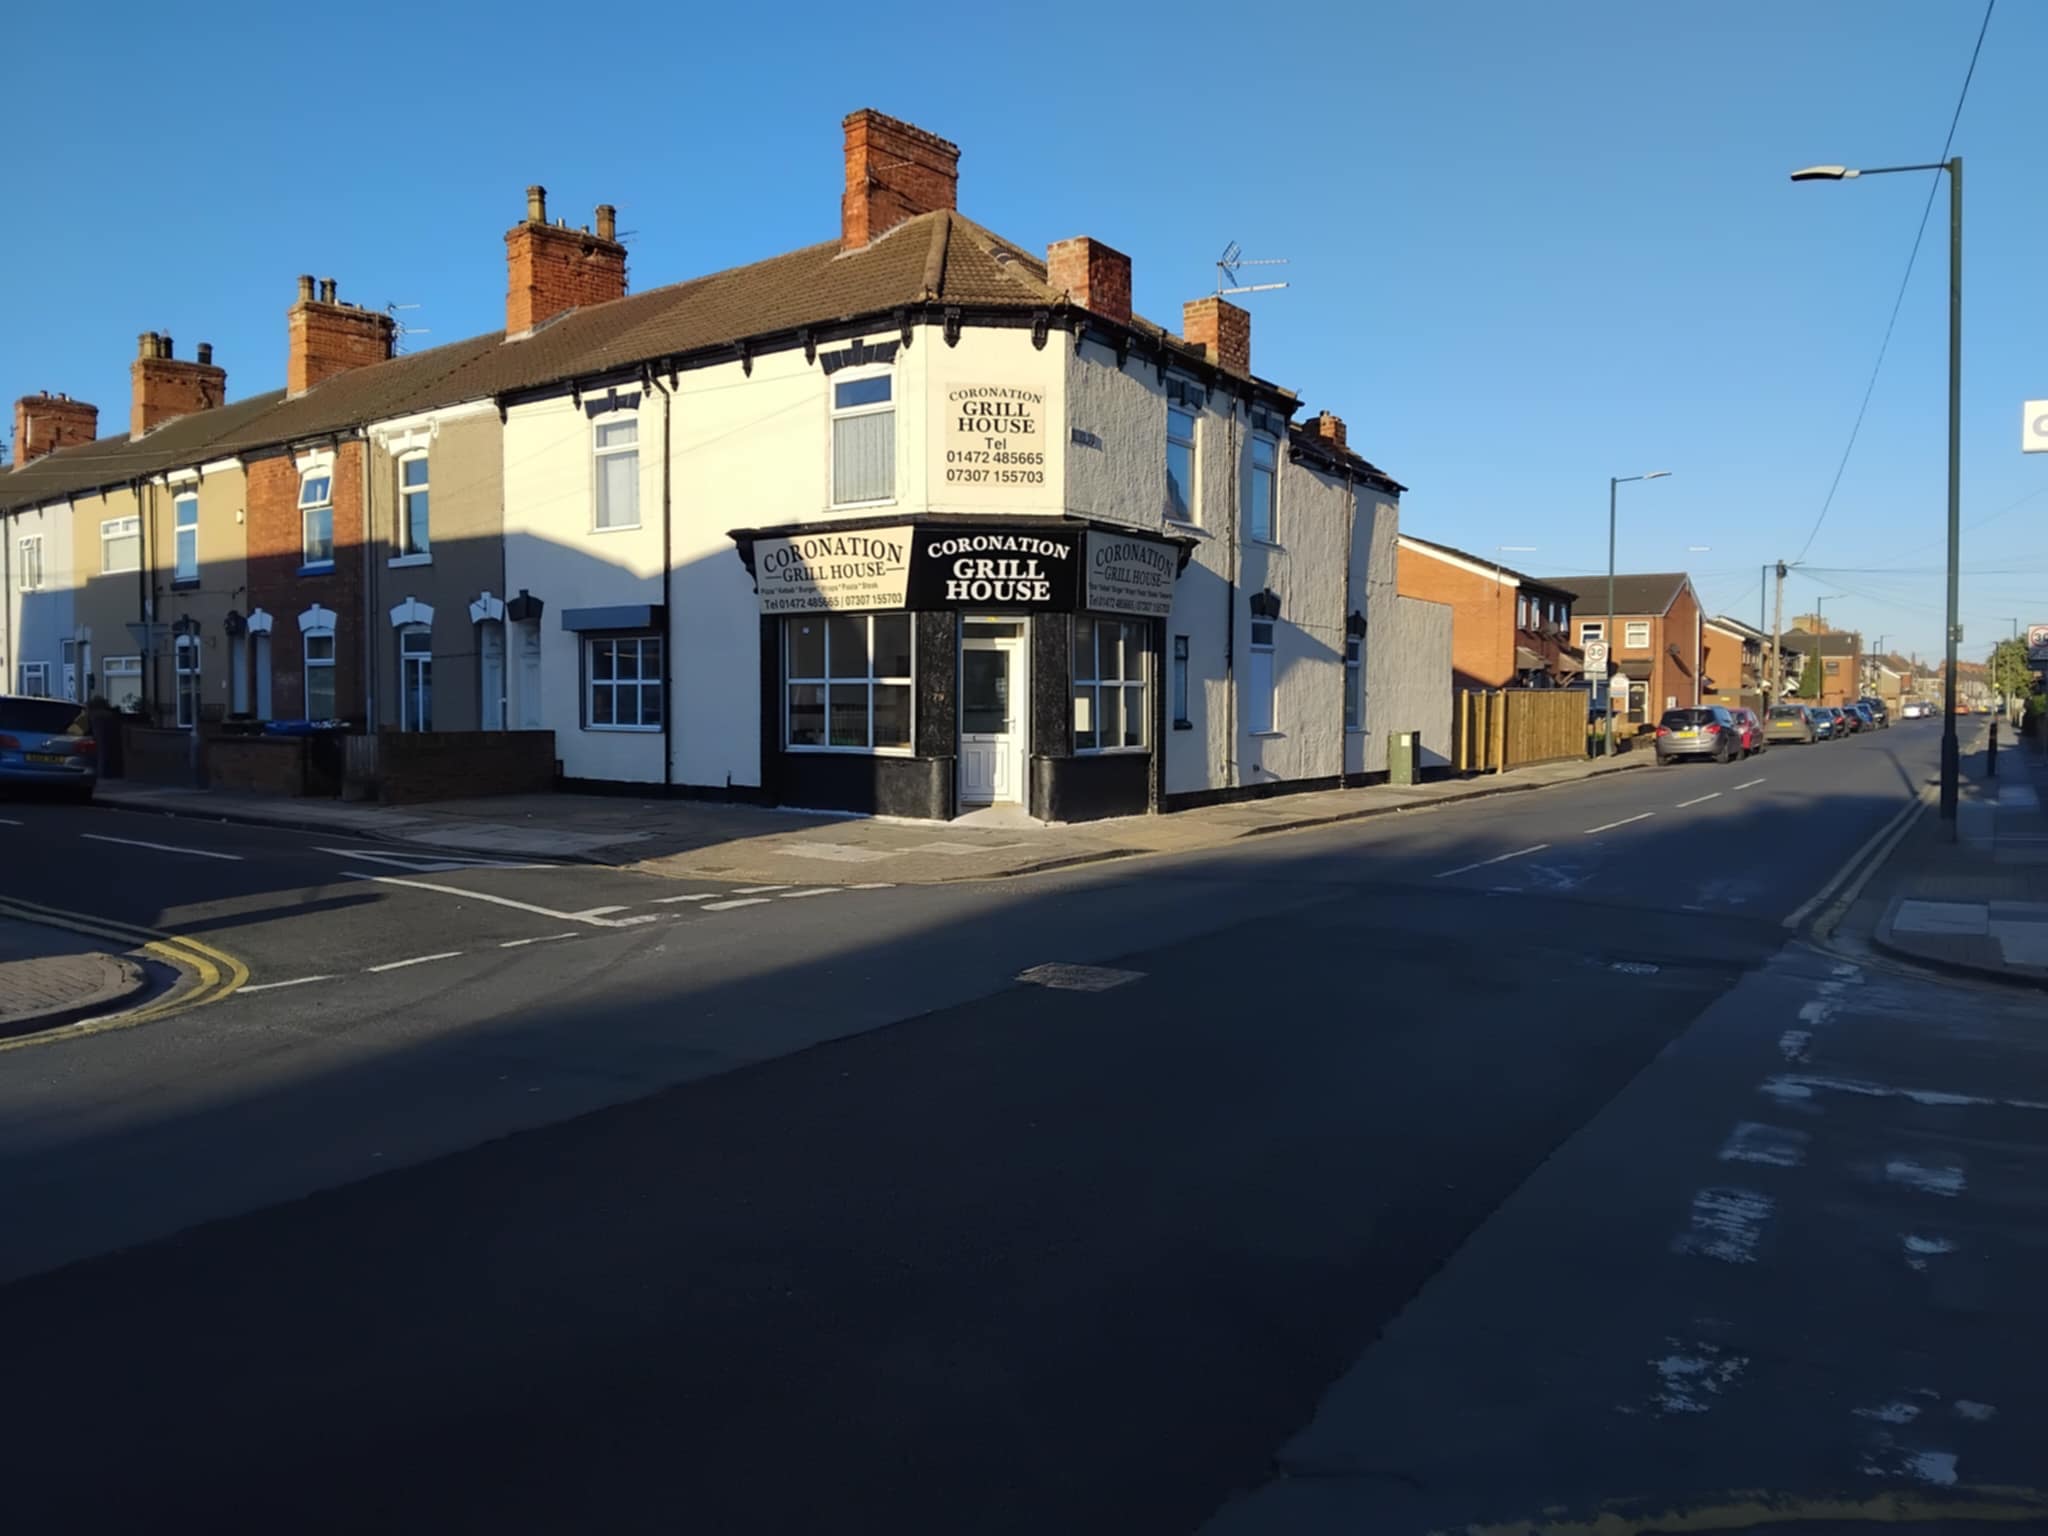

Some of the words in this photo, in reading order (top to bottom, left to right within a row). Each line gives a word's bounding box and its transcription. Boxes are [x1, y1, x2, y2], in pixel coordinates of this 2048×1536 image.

[949, 387, 1042, 404] CORONATION
[962, 400, 1031, 418] GRILL
[958, 417, 1035, 434] HOUSE
[984, 437, 1007, 450] Tel
[946, 450, 990, 464] 01472
[992, 451, 1044, 465] 485665
[946, 468, 990, 482] 07307
[994, 469, 1044, 483] 155703
[763, 537, 903, 573] CORONATION
[927, 535, 1071, 560] CORONATION
[953, 558, 1045, 579] GRILL
[1095, 543, 1174, 578] CORONATION
[783, 566, 828, 583] GRILL
[831, 561, 886, 580] HOUSE
[1104, 565, 1131, 583] GRILL
[1132, 569, 1162, 588] HOUSE
[945, 580, 1051, 601] HOUSE
[764, 600, 778, 610] Tel
[779, 598, 806, 609] 01472
